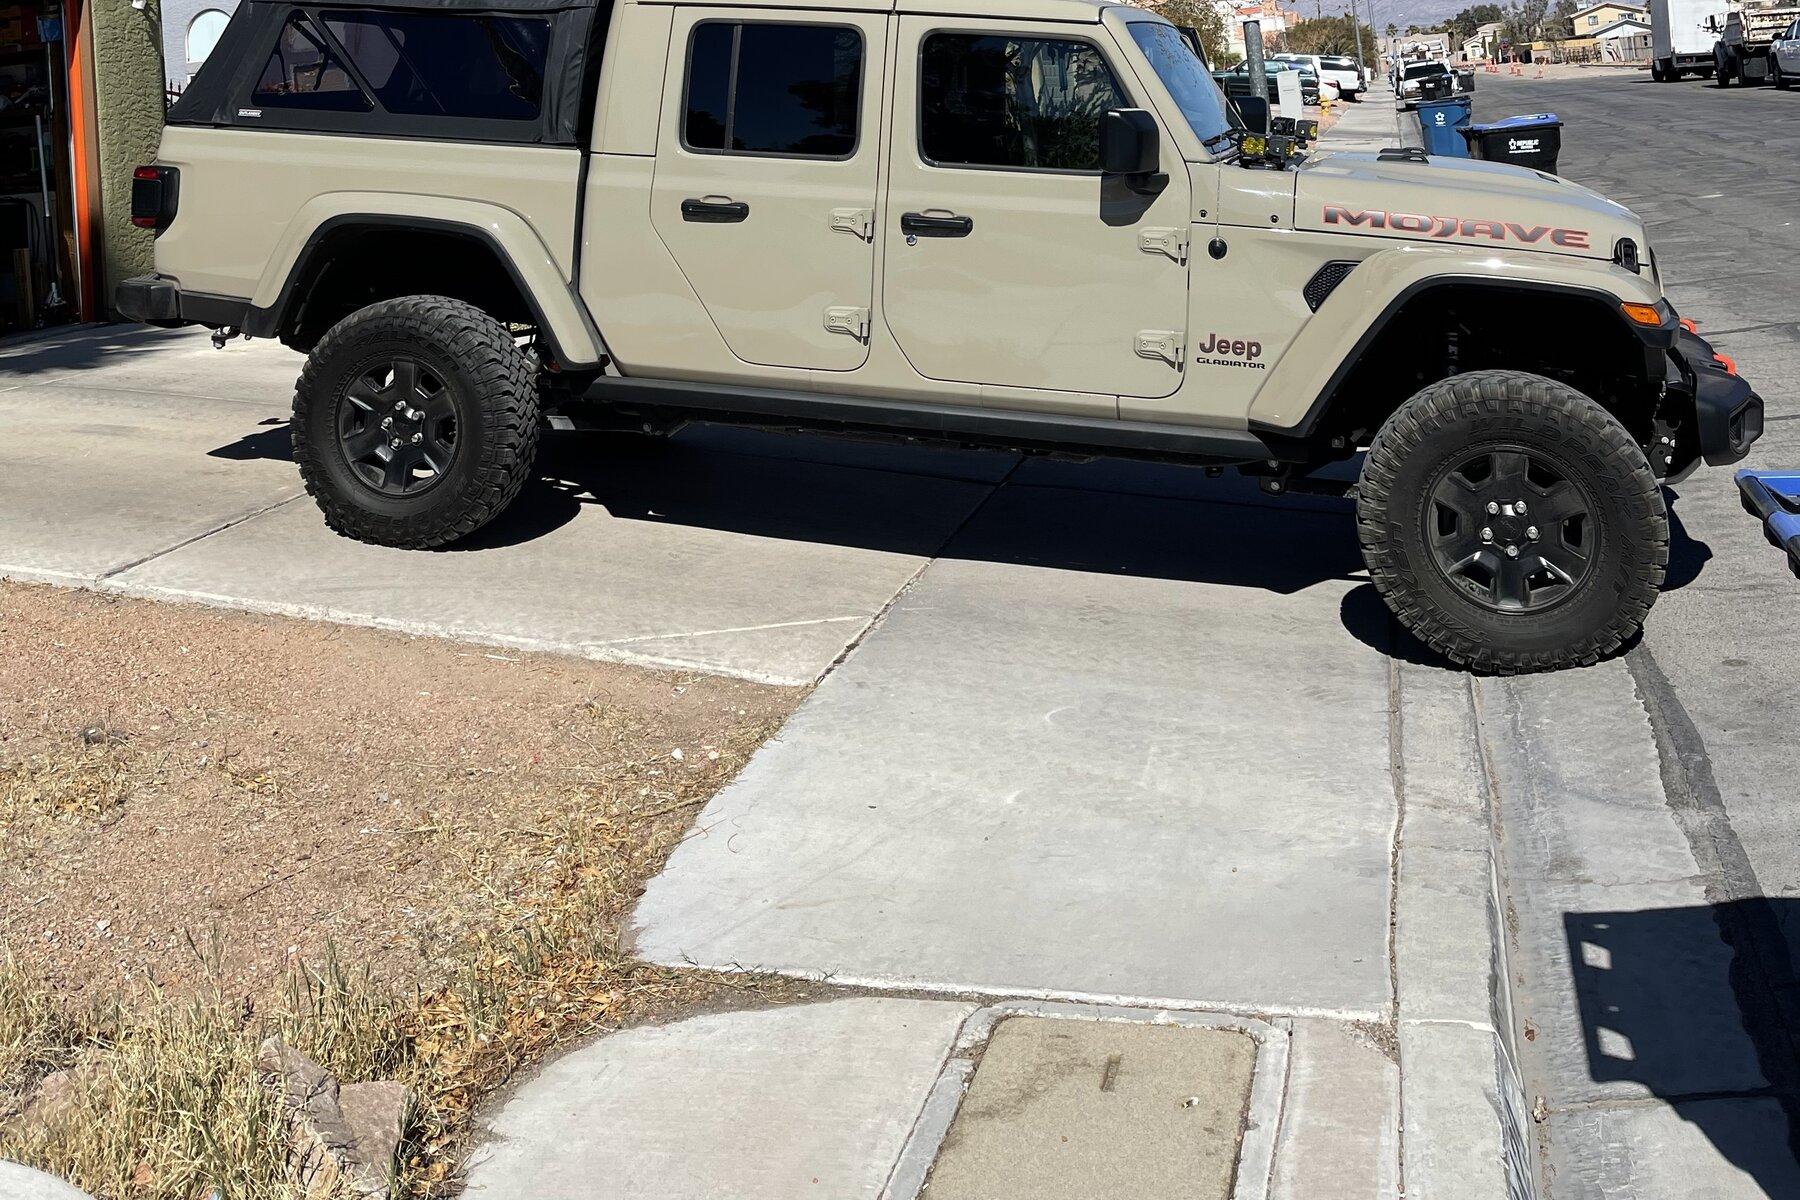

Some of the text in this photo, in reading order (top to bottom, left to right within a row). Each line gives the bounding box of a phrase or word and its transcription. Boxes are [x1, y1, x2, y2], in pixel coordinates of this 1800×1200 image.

[1323, 205, 1591, 249] MOJAVE
[1199, 333, 1262, 361] Jeep
[1196, 357, 1266, 370] GLADIATOR
